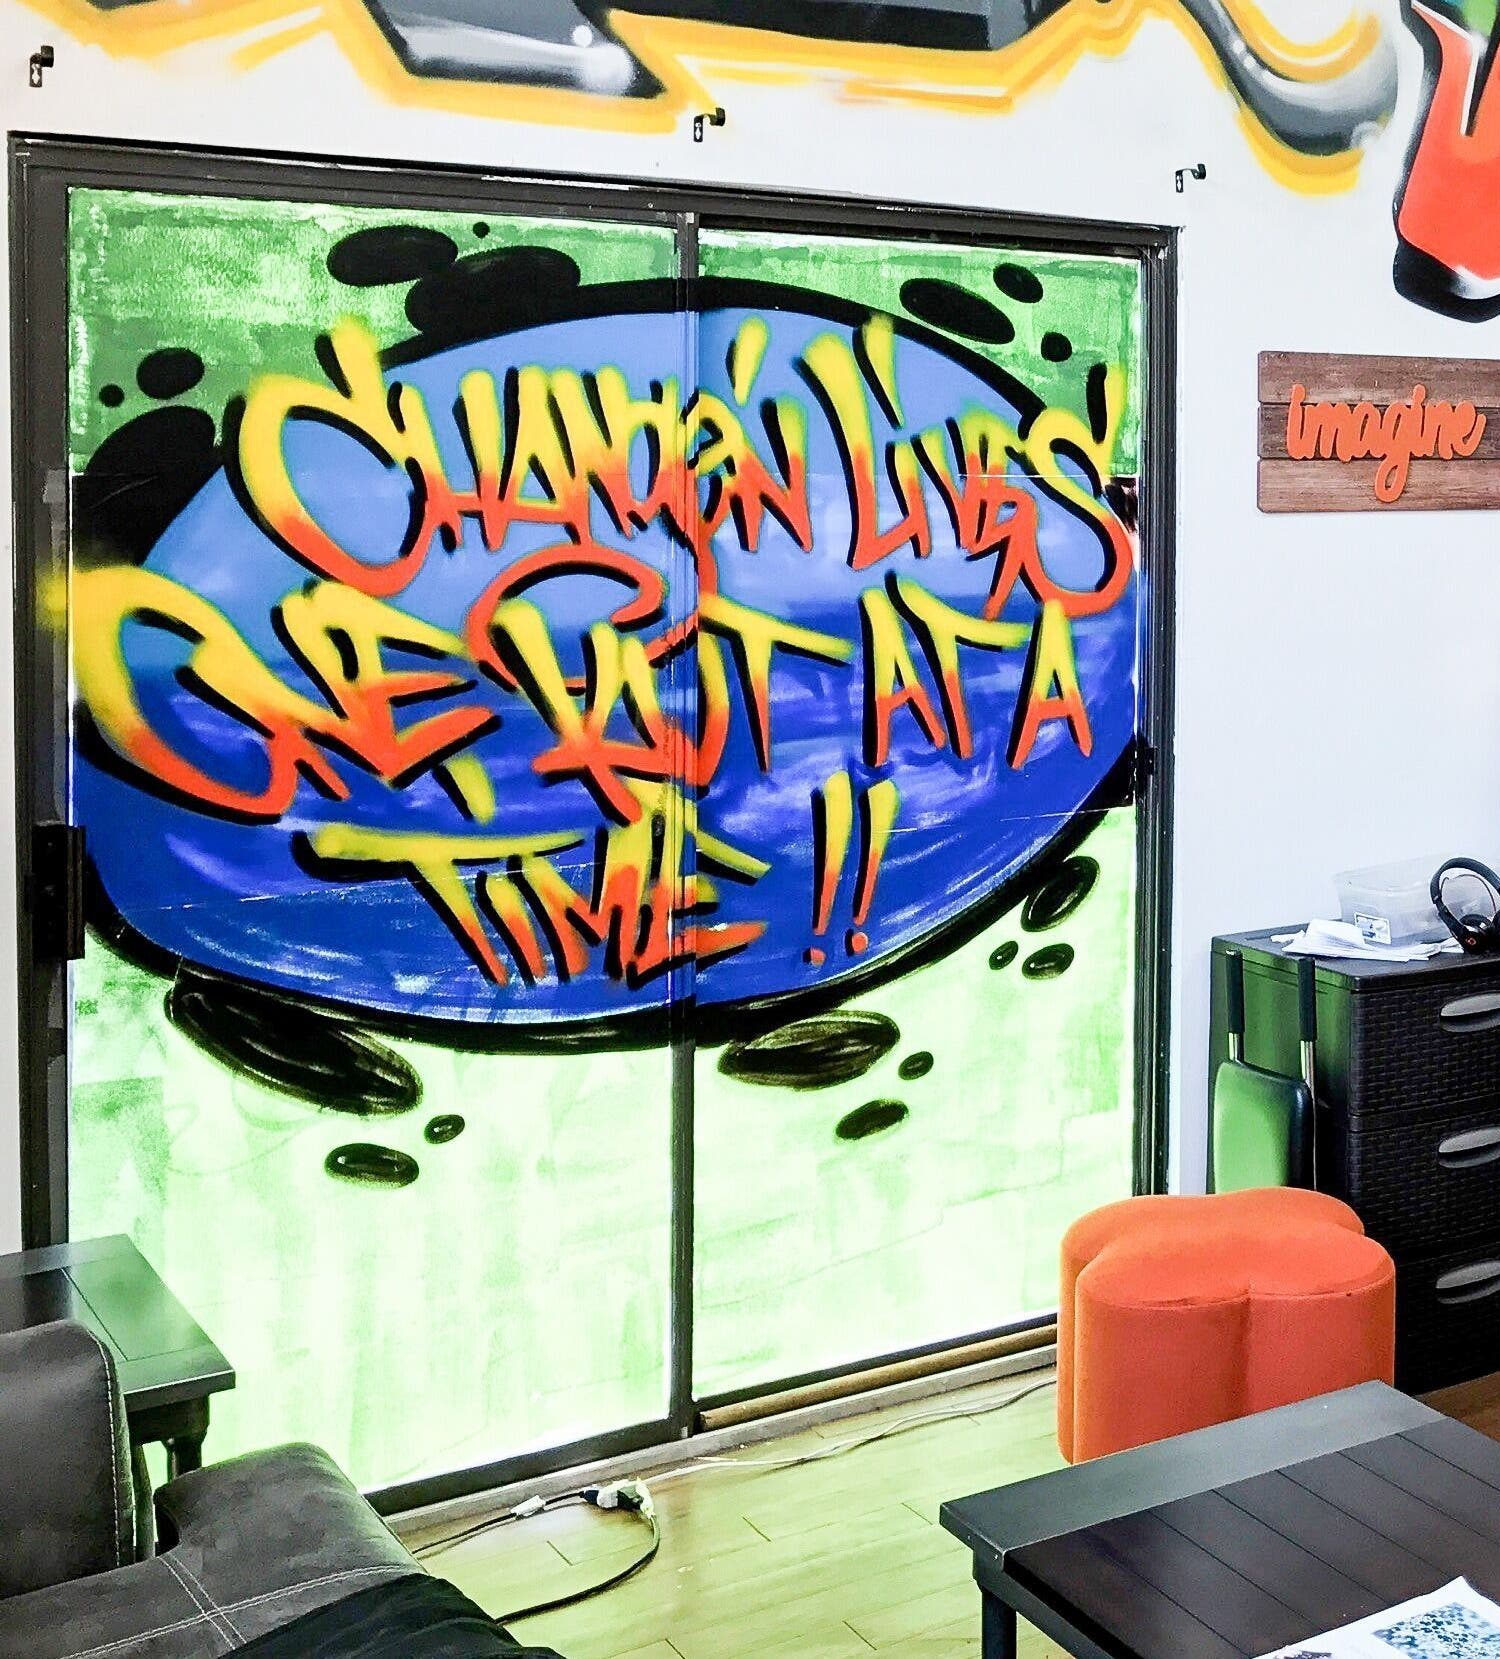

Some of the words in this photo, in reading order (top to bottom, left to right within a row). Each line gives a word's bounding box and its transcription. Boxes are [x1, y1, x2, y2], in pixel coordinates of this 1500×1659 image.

[1287, 384, 1487, 503] imagine
[70, 564, 498, 822] ONE
[860, 571, 1034, 769] AT
[1005, 598, 1093, 771] A
